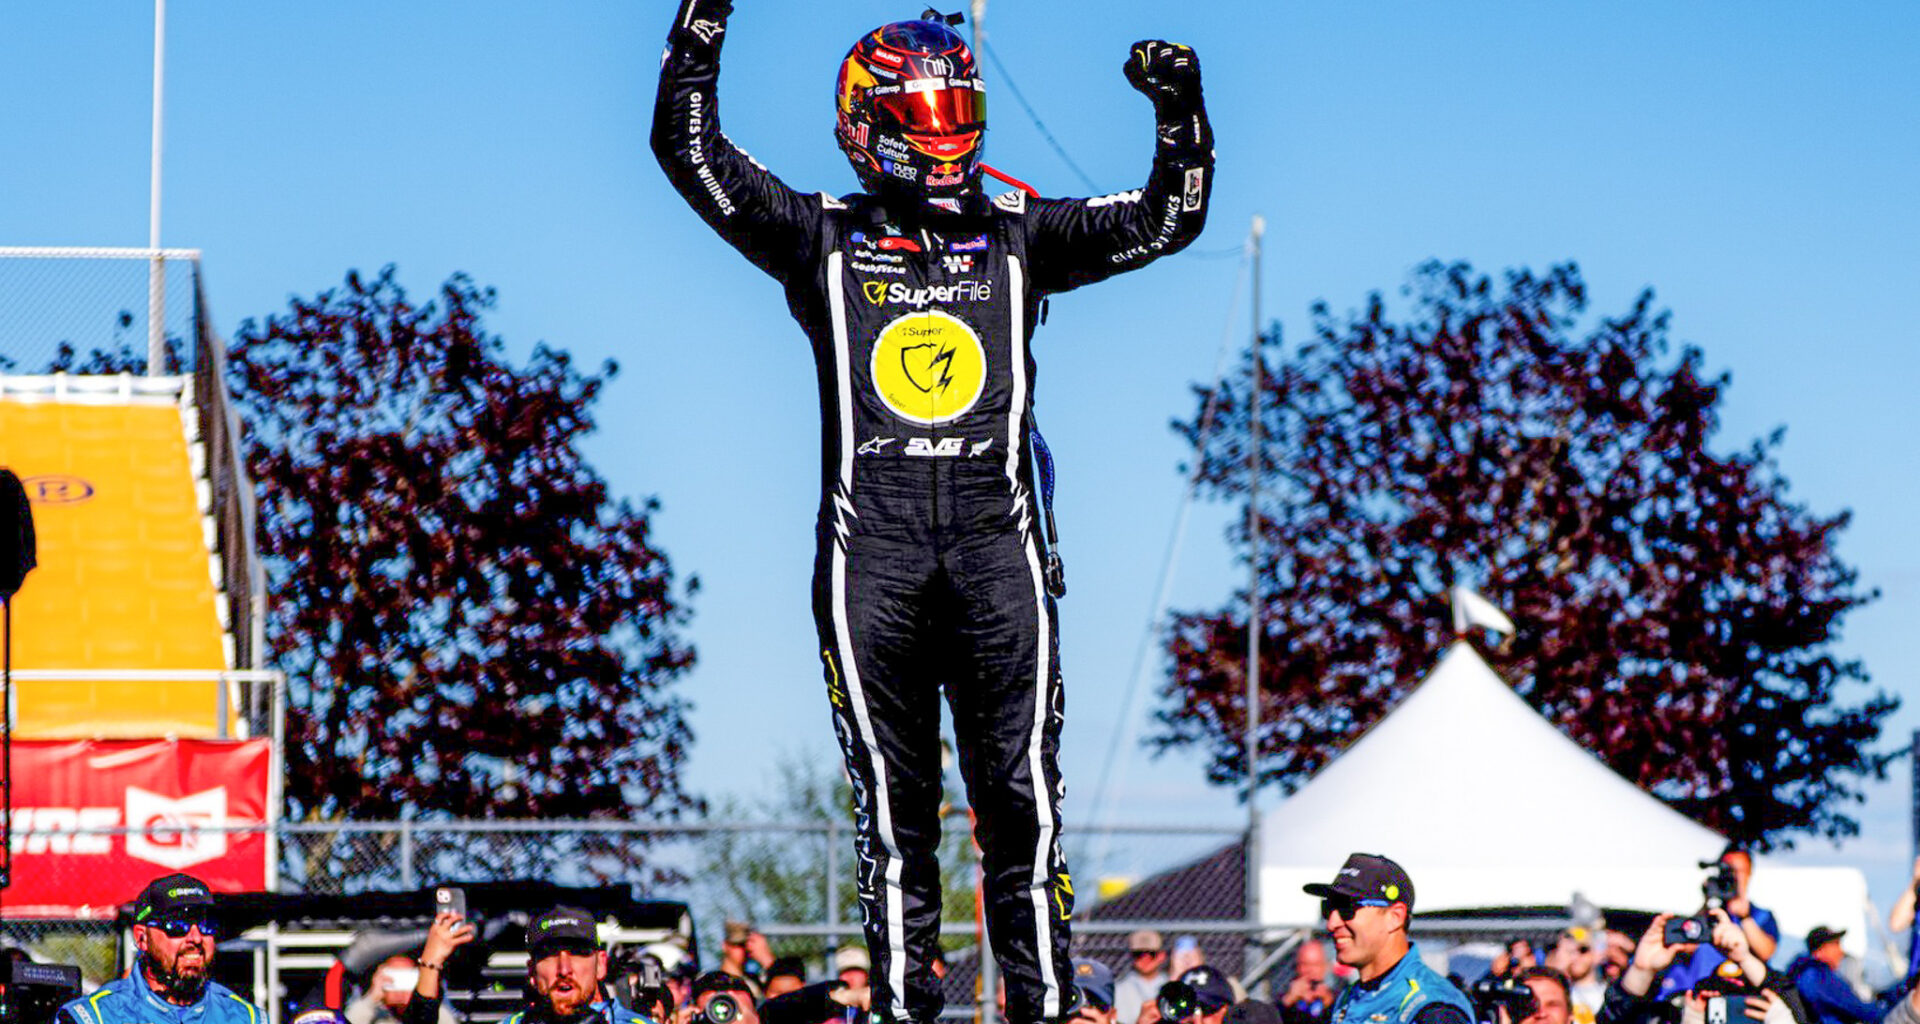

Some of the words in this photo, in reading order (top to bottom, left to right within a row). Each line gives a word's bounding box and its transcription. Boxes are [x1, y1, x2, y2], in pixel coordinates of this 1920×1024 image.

[689, 91, 702, 133] GIVES
[689, 135, 705, 165] YOU
[876, 144, 910, 161] Culture
[879, 134, 909, 153] Safety
[697, 165, 736, 216] WIIINGS
[904, 437, 966, 457] SVG
